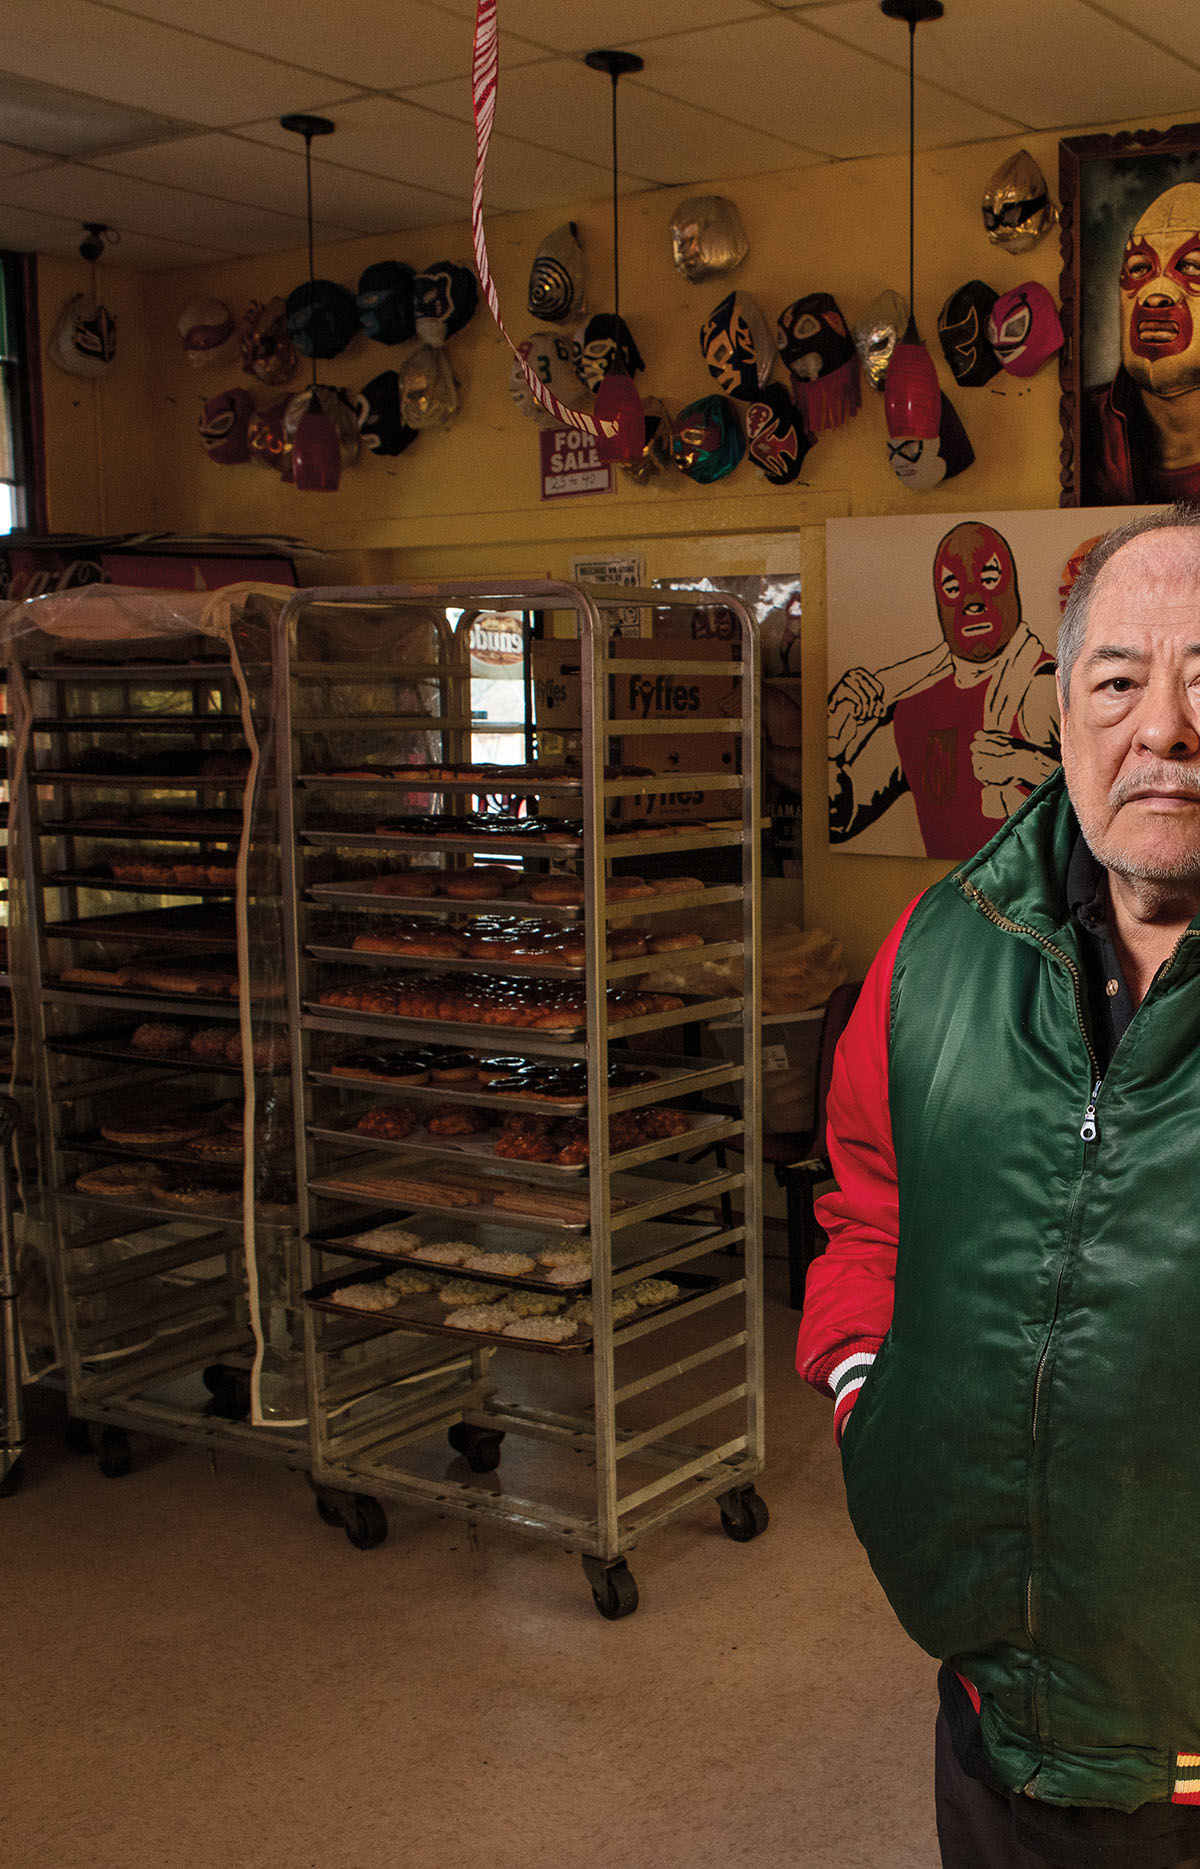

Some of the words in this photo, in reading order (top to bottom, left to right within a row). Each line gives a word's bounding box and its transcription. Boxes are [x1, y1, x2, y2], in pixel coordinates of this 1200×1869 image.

[554, 430, 596, 451] FOR
[550, 448, 601, 474] SALE
[629, 674, 700, 719] Fyffes
